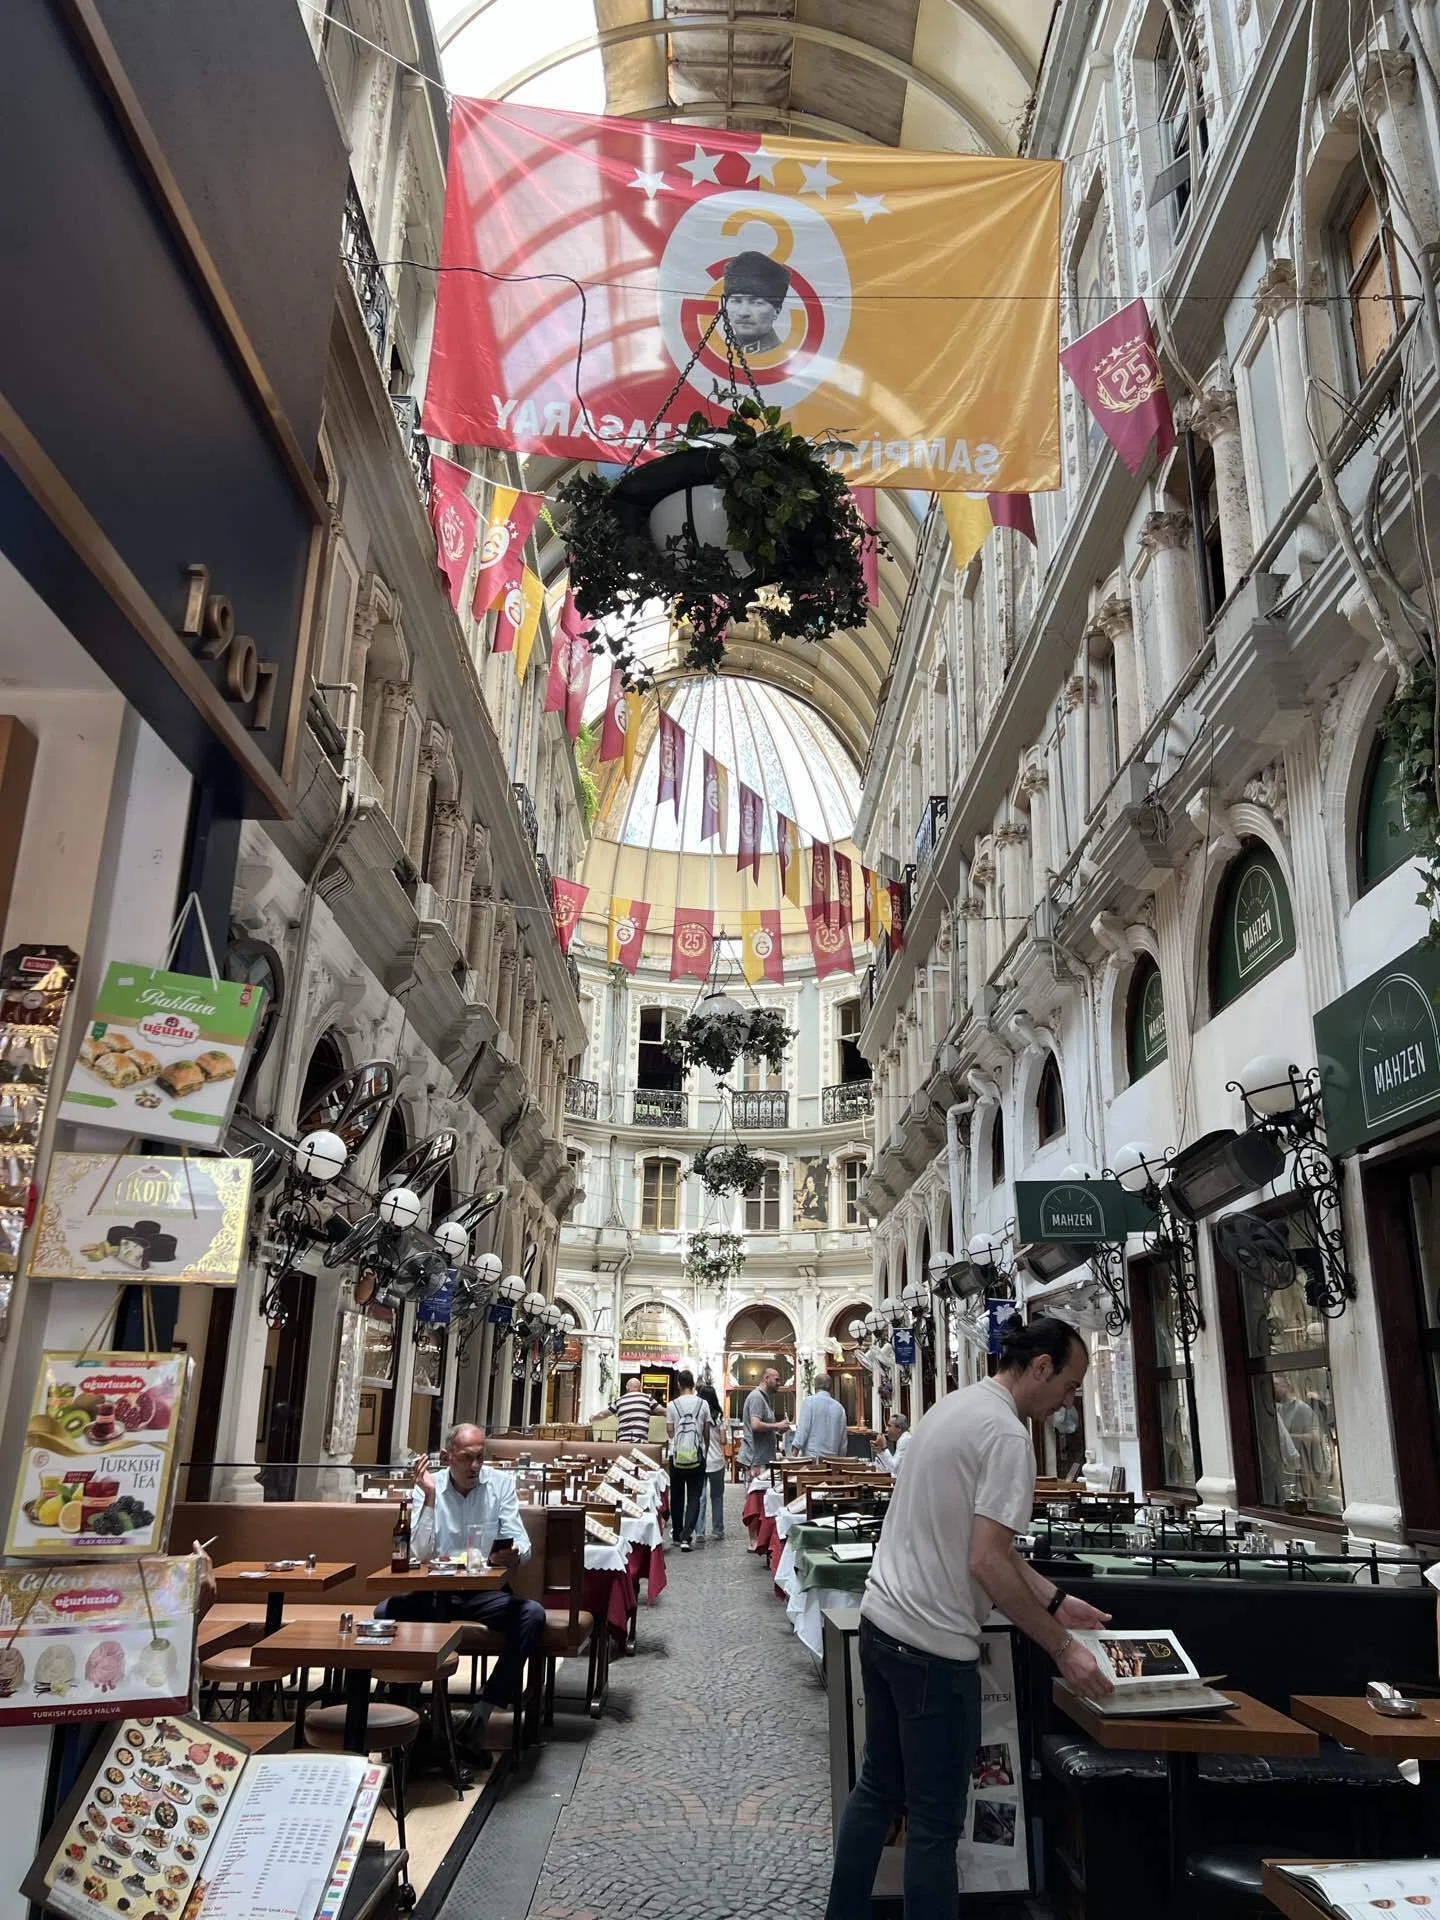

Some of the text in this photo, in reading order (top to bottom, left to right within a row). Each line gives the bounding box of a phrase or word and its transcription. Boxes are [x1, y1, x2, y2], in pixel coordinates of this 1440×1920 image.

[1111, 353, 1151, 399] 25
[821, 928, 838, 945] 25
[1242, 909, 1272, 953] MAHZEN
[684, 934, 701, 949] 25
[136, 988, 217, 1016] Baklava
[143, 1022, 194, 1039] uğurlu
[1148, 1012, 1166, 1042] MAHZE
[1374, 1041, 1426, 1096] MAHZEN
[1051, 1213, 1093, 1226] MAHZEN
[100, 1456, 161, 1473] TURKISH
[133, 1472, 156, 1488] TEA
[32, 1706, 121, 1719] TURKISH FLOSS HALVA
